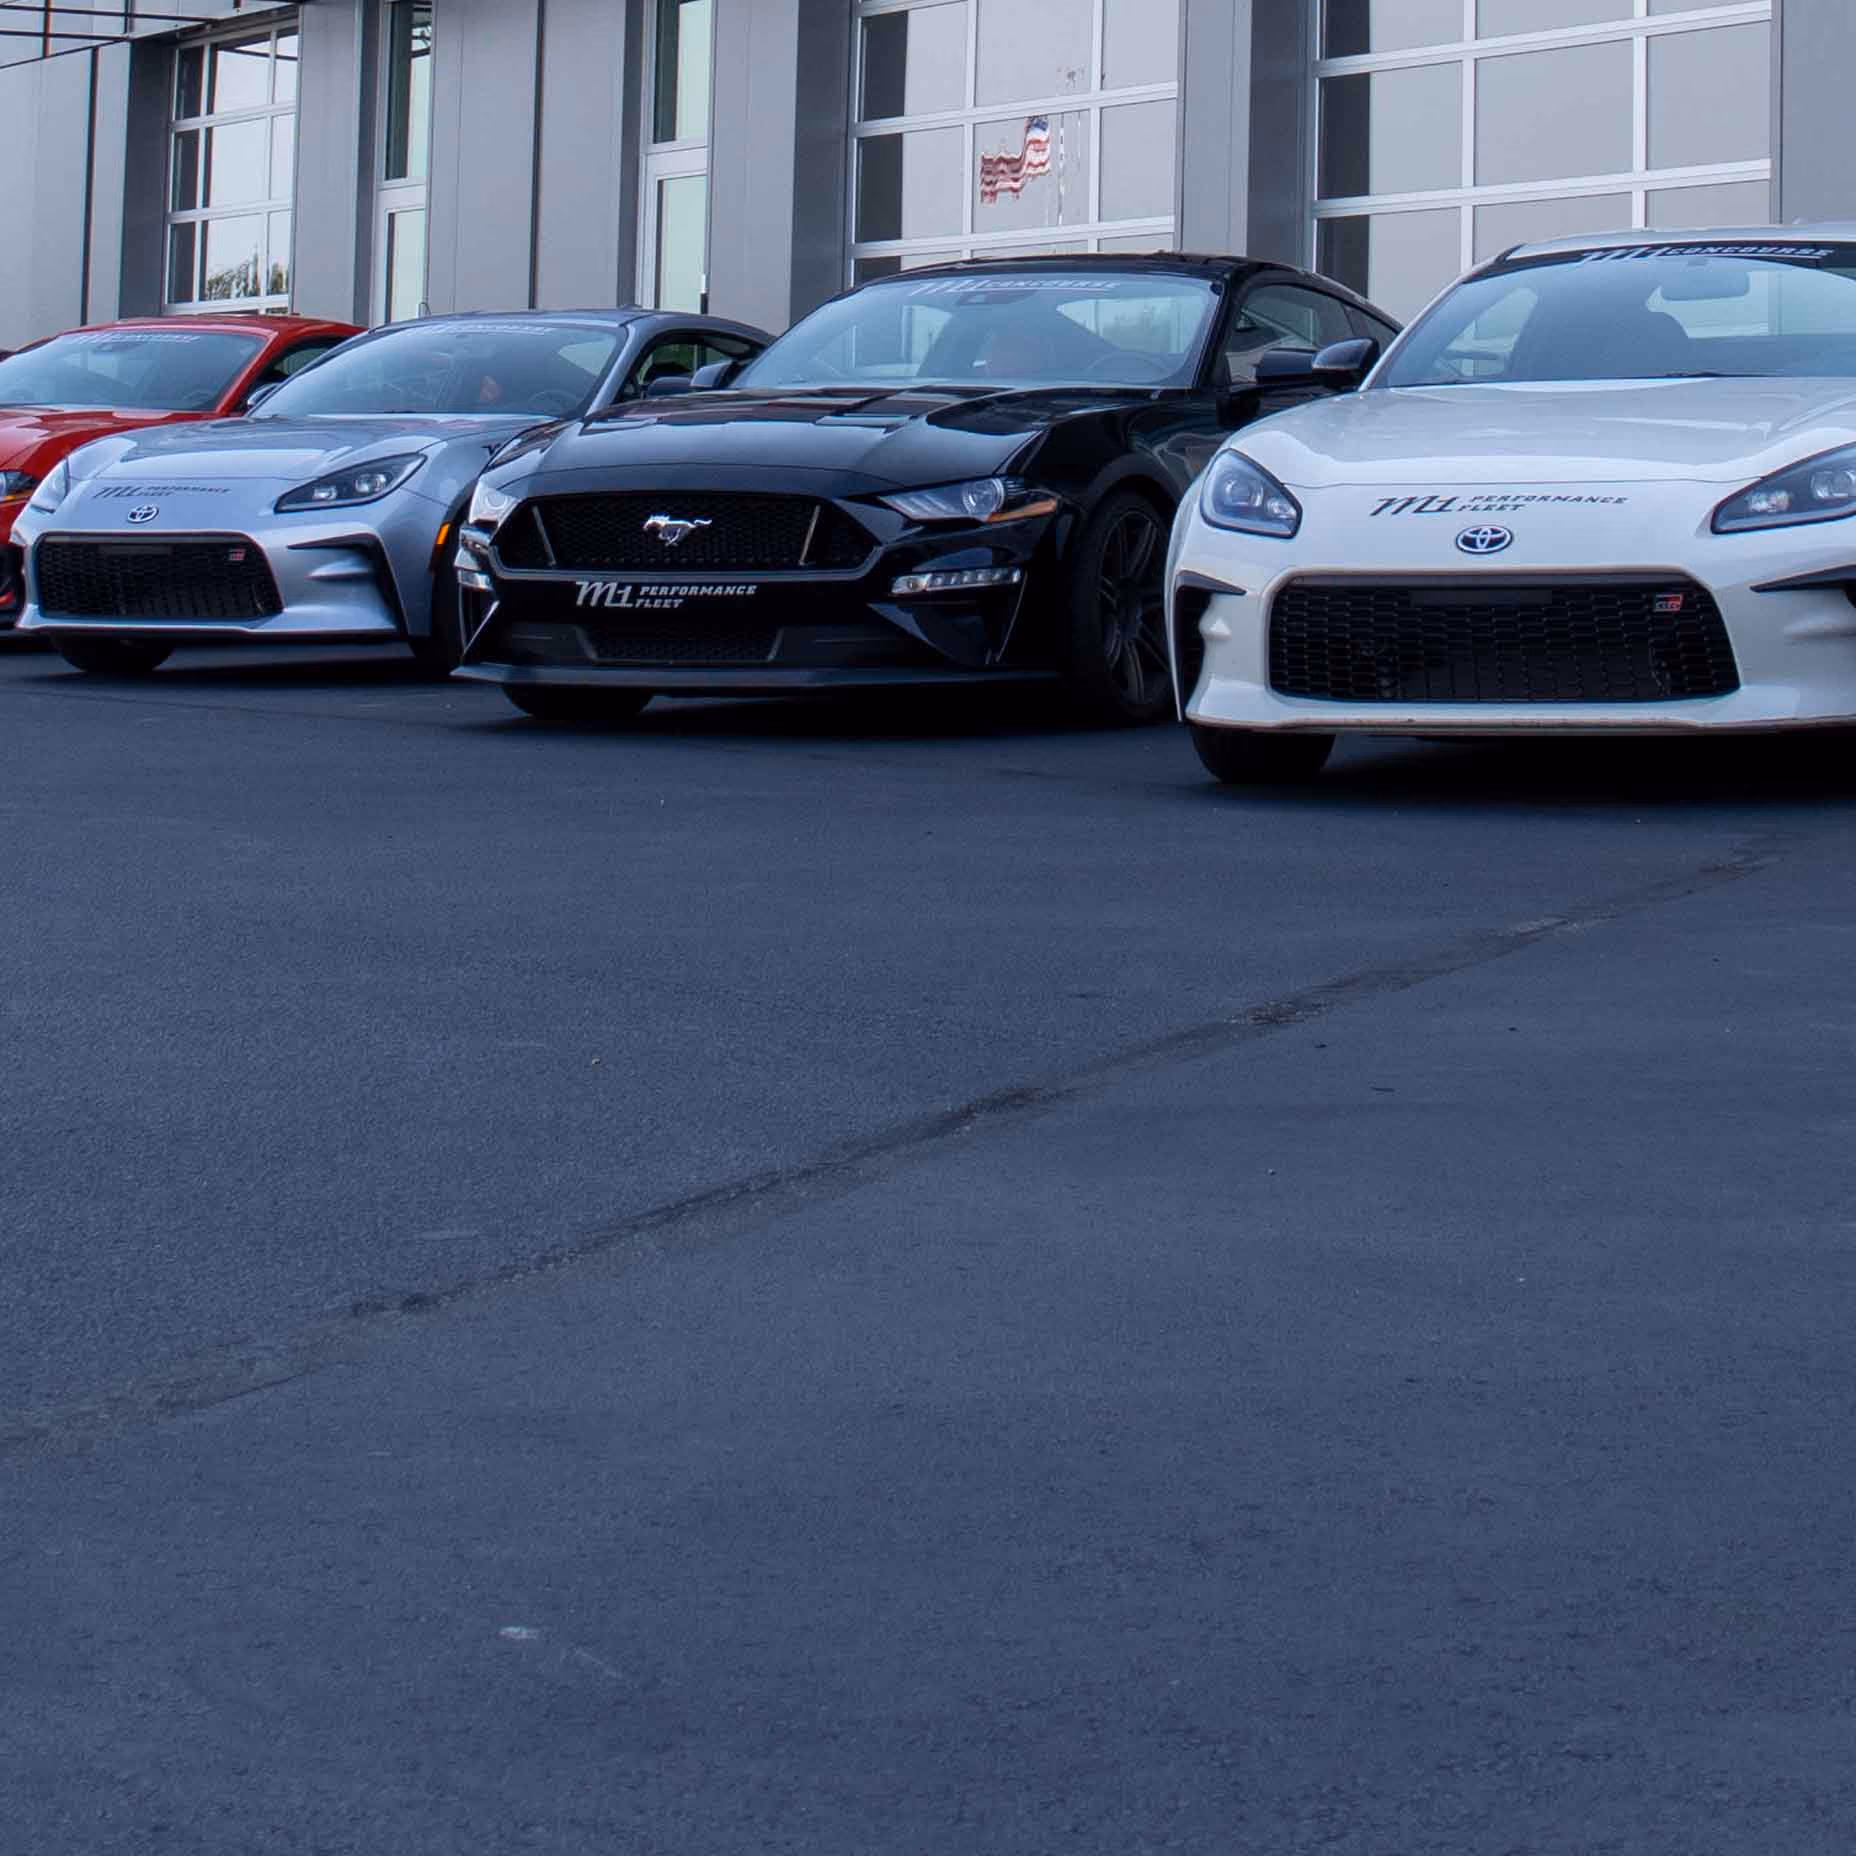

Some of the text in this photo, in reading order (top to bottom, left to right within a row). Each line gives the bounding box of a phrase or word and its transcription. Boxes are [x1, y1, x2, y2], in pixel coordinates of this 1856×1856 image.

[1665, 246, 1835, 258] CONCOURSE
[1369, 495, 1630, 518] M1 PERFORMANCE
[1456, 503, 1526, 513] FLEET
[575, 581, 759, 608] M1 PERFORMANCE
[634, 598, 684, 609] FLEET
